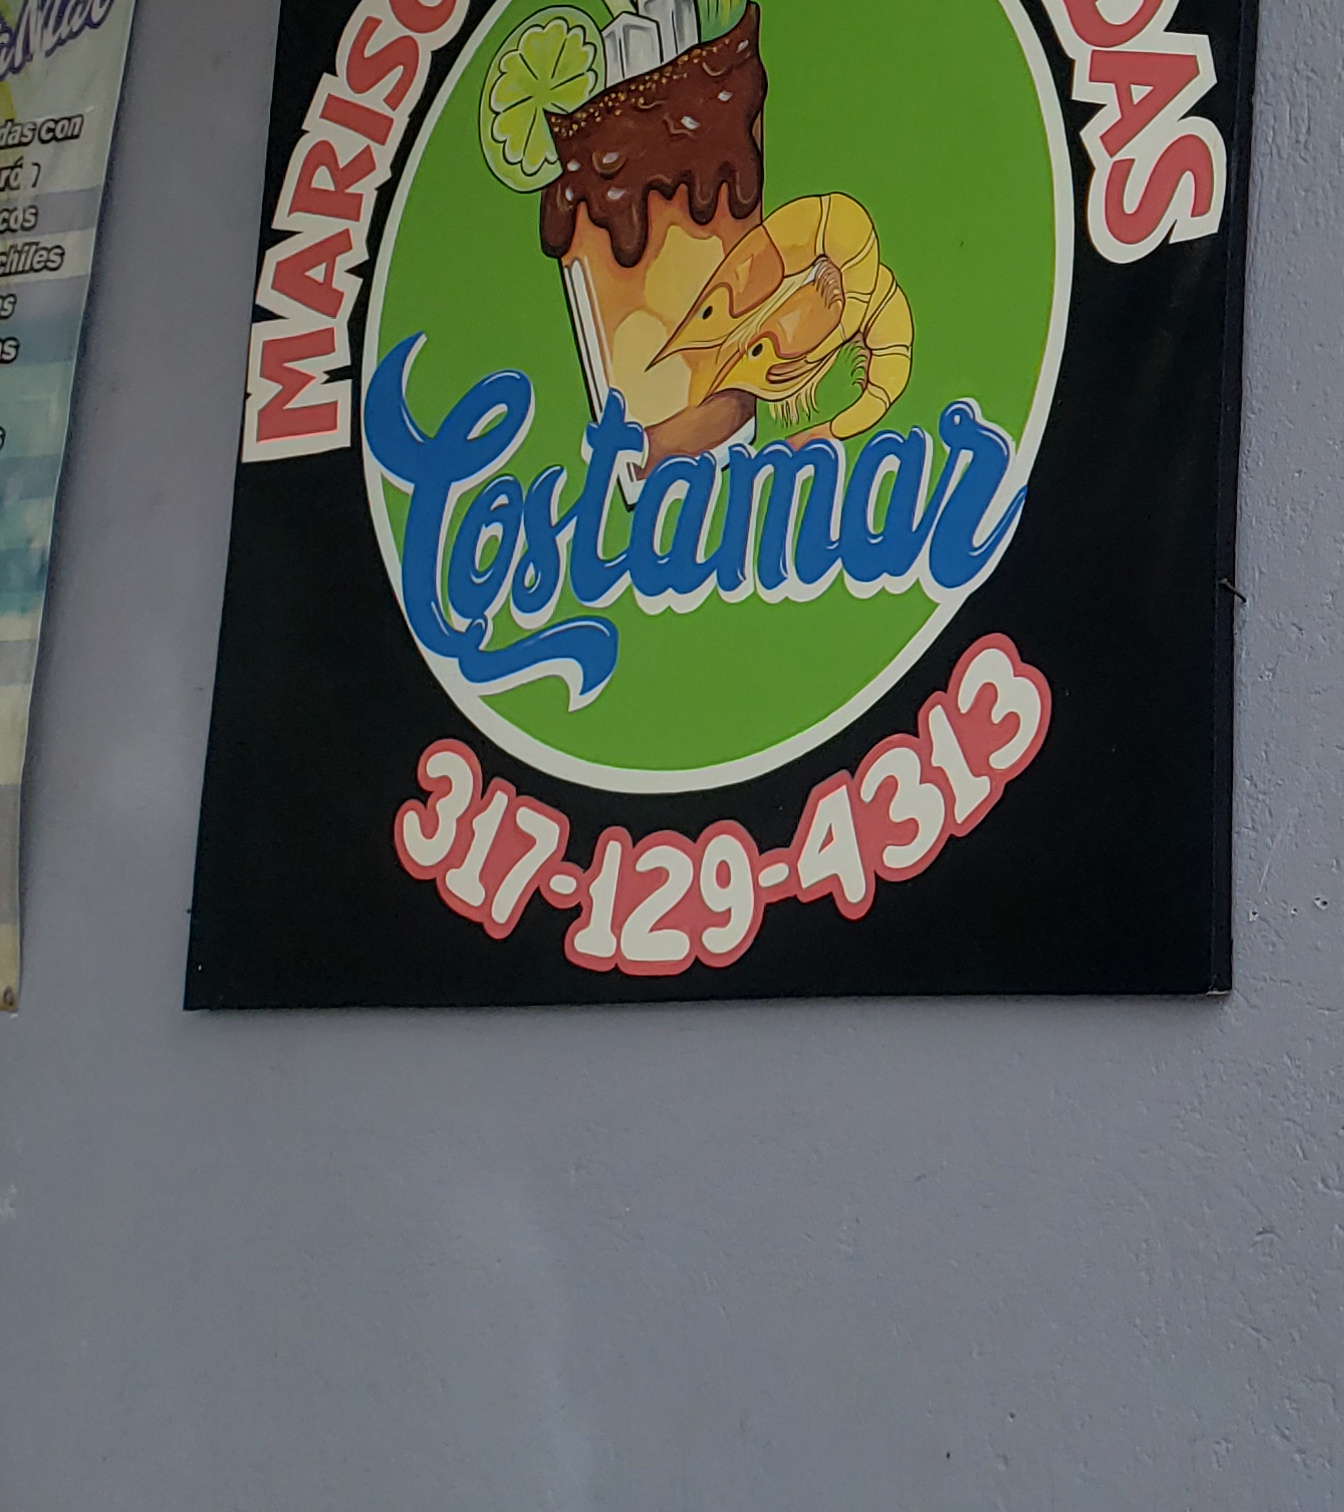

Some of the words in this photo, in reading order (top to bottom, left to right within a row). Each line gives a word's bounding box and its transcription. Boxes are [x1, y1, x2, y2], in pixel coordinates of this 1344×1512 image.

[38, 114, 84, 145] con
[364, 330, 1028, 704] Costamar
[398, 640, 1046, 968] 317-129-4313
